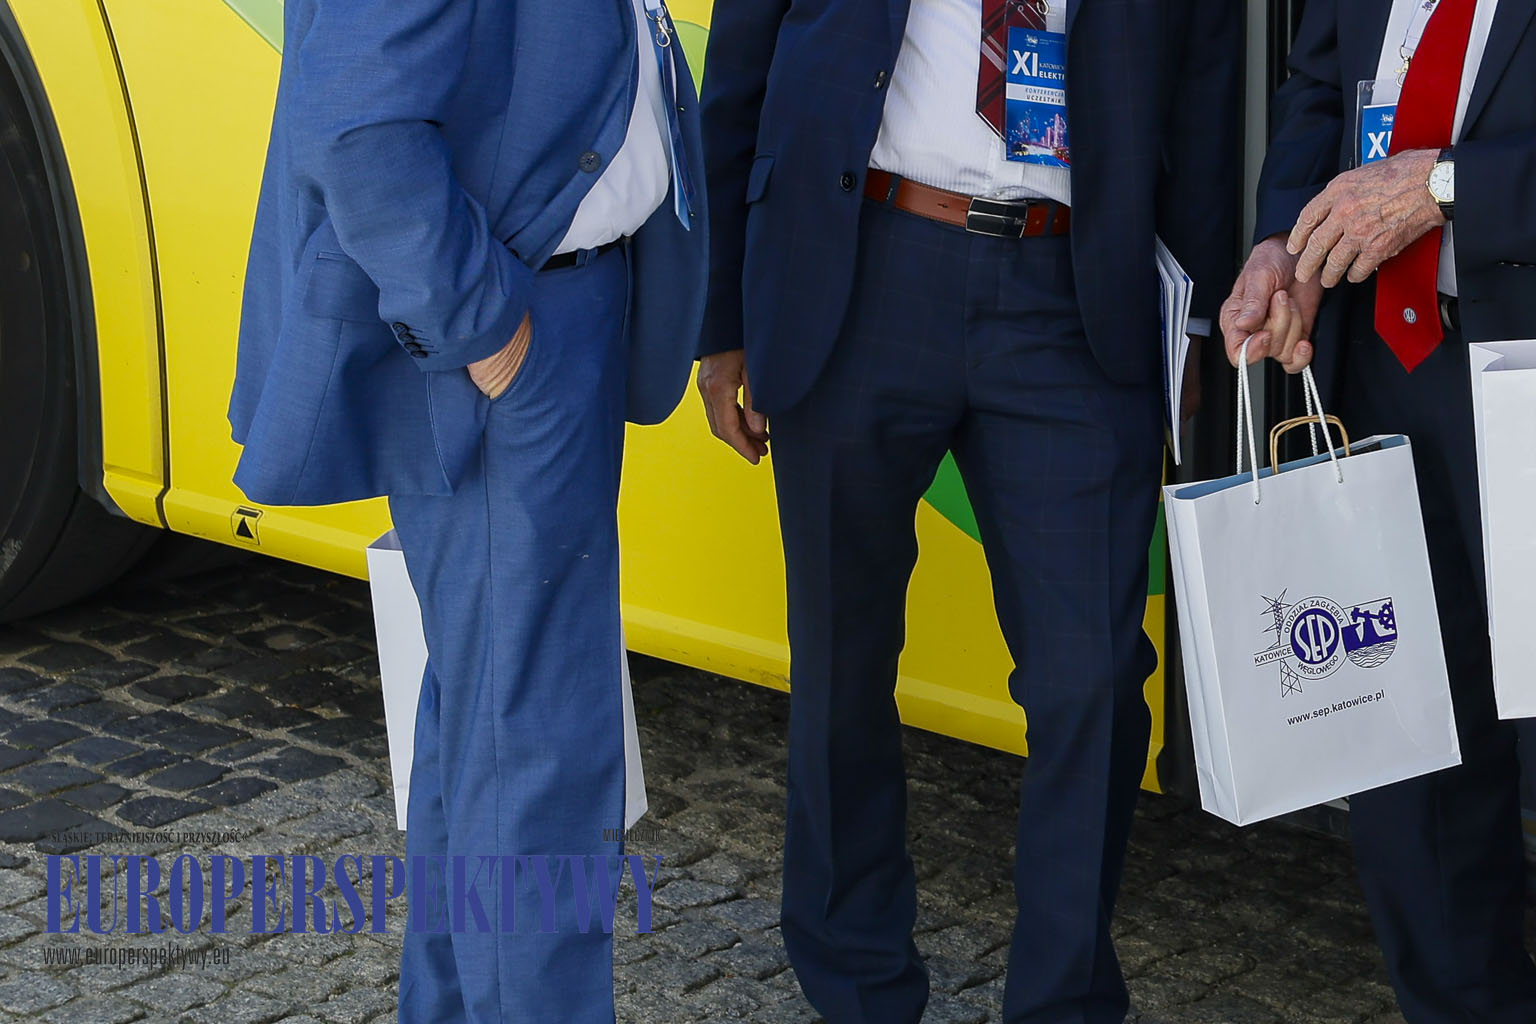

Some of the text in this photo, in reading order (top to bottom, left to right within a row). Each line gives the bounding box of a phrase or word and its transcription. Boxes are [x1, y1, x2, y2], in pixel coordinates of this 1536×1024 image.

[1012, 49, 1039, 78] XI
[1284, 600, 1344, 634] ODDZIAŁ ZAGŁĘBIA
[1294, 613, 1336, 662] SEP
[1254, 646, 1293, 664] KATOWICE
[1297, 654, 1339, 675] WĘGLOWEGO
[1288, 689, 1386, 726] www.sep.katowice.pl
